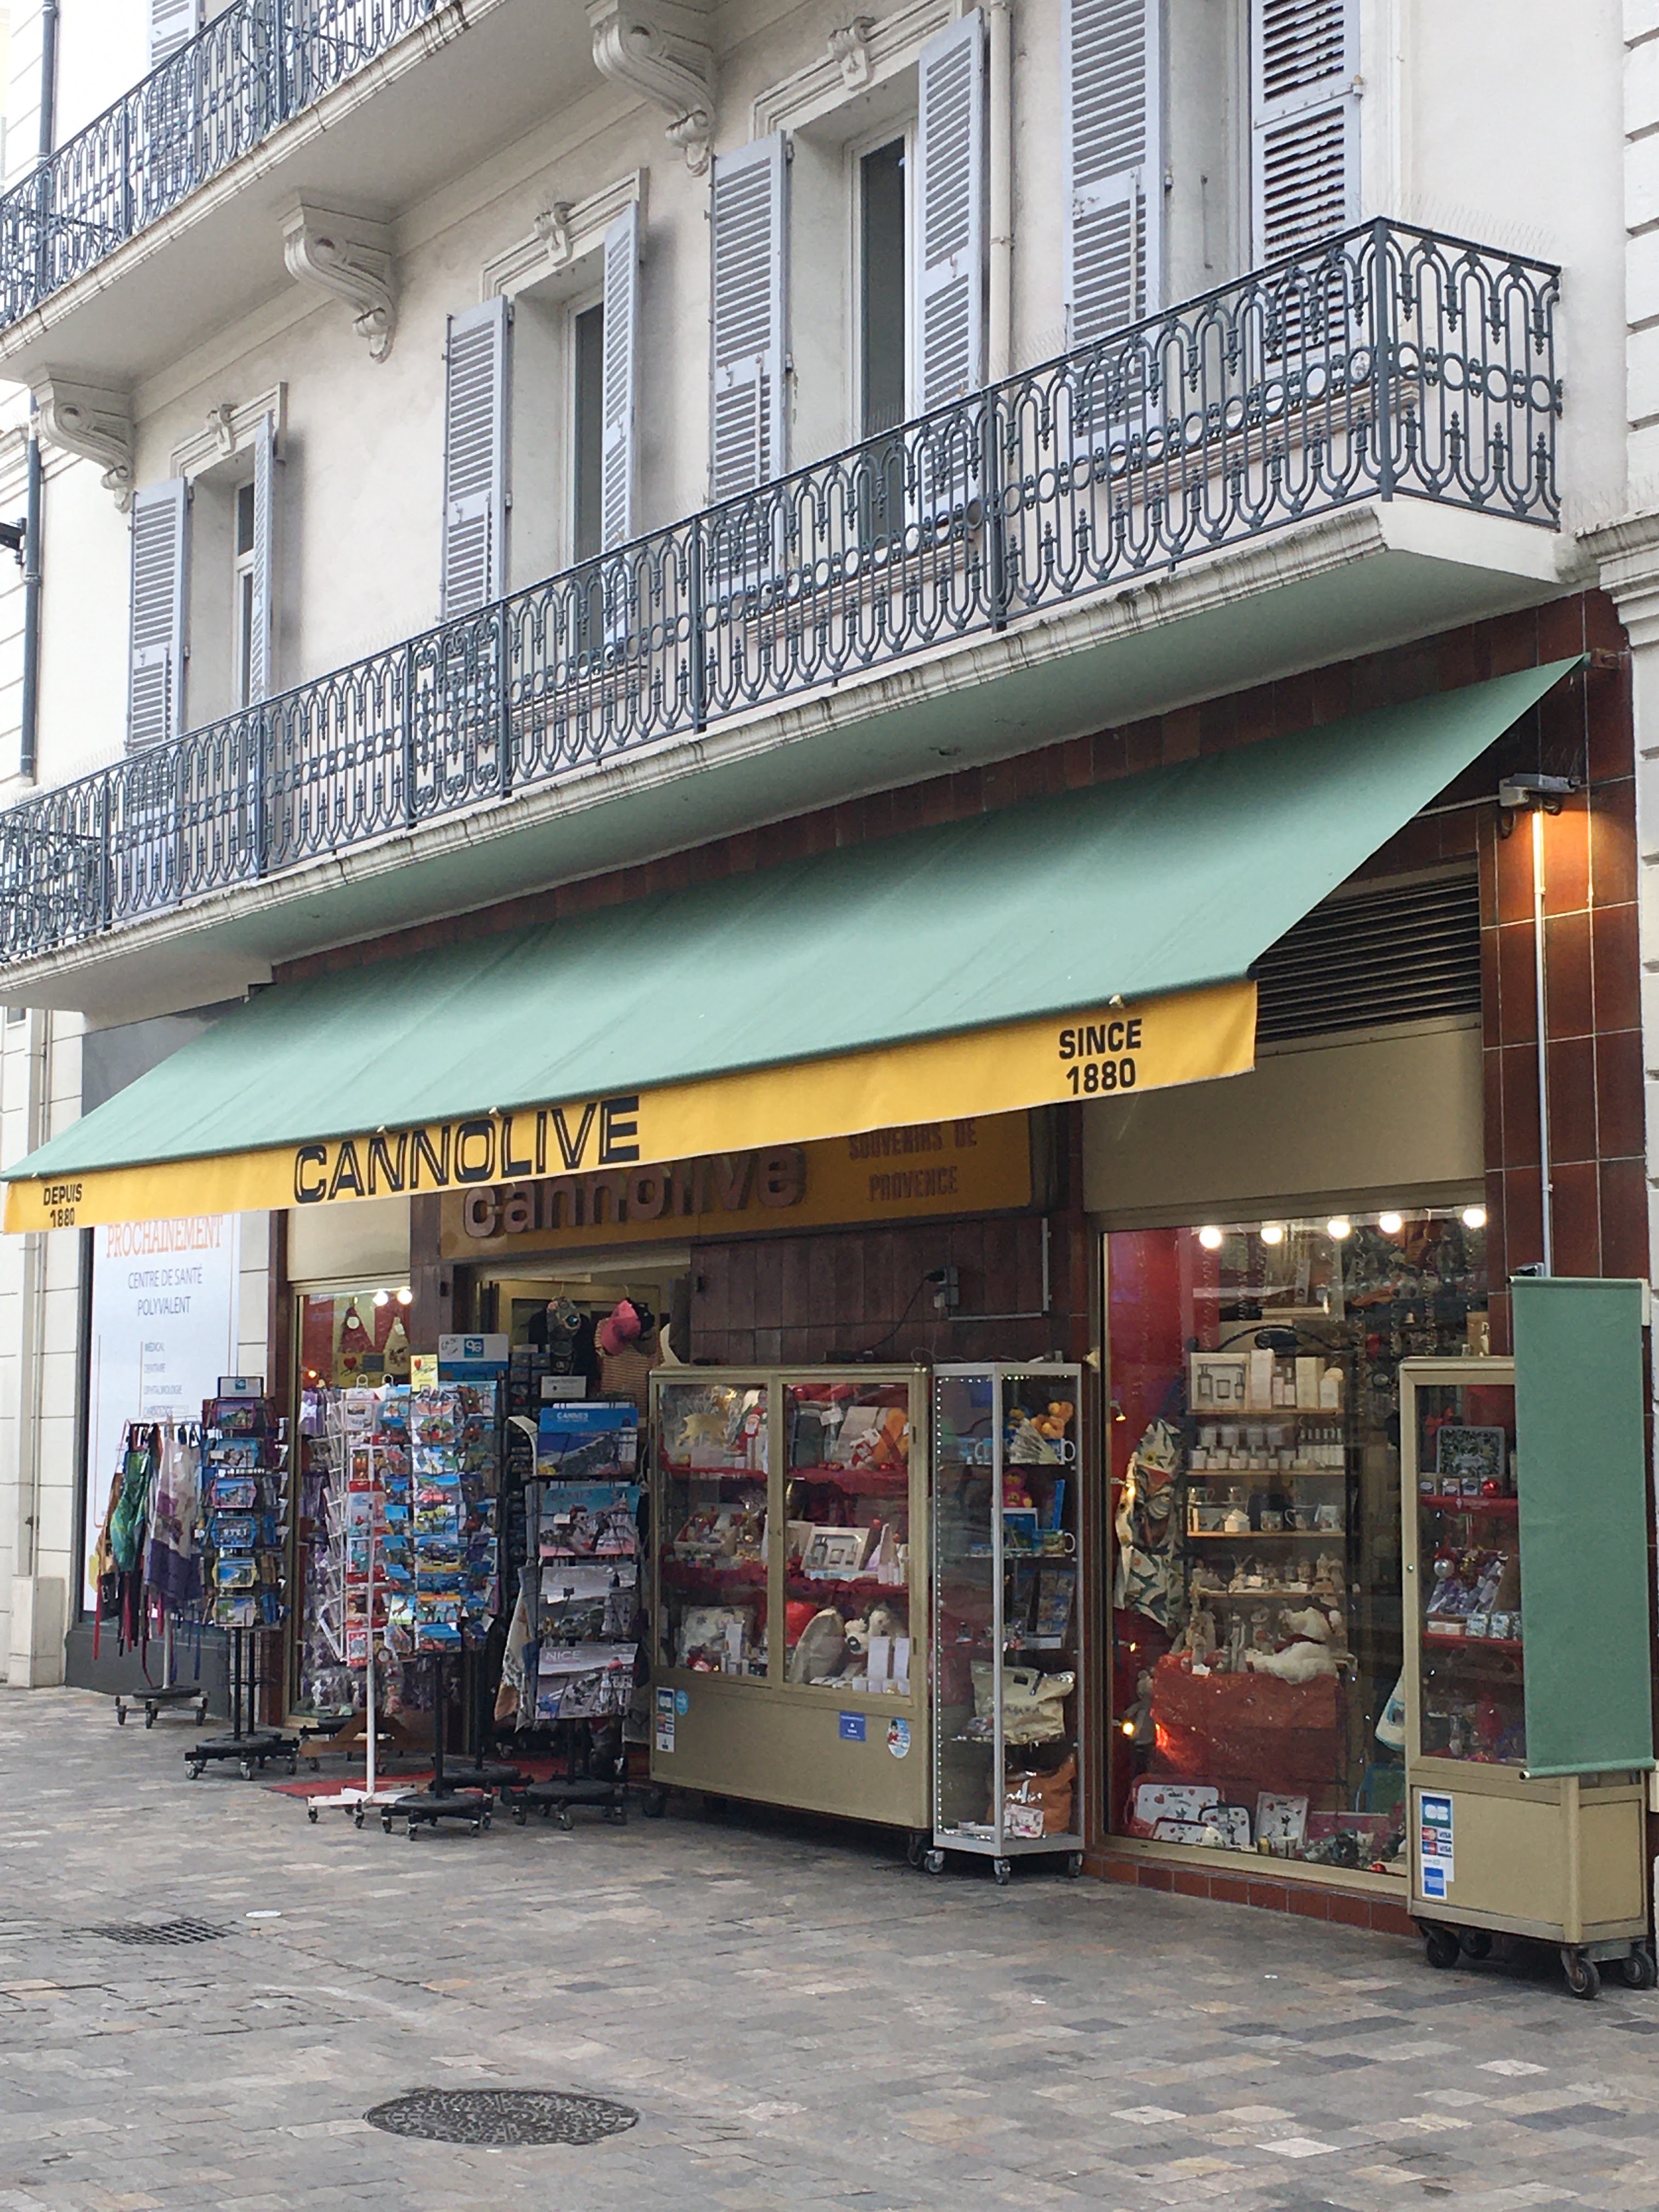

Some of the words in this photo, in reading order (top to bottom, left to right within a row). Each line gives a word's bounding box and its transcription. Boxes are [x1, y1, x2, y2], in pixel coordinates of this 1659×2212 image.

[1059, 1018, 1142, 1059] SINCE
[1066, 1058, 1136, 1095] 1880
[294, 1096, 640, 1204] CANNOLIVE
[848, 1124, 943, 1159] SOUVENIRS
[953, 1118, 977, 1147] DE
[43, 1183, 82, 1205] DEPUIS
[868, 1166, 959, 1201] PROVENCE
[50, 1207, 75, 1228] 1880
[106, 1215, 223, 1258] PROCHAINEMENT
[128, 1269, 160, 1289] CENTRE
[162, 1269, 173, 1287] DE
[175, 1263, 203, 1285] SANTÉ
[137, 1296, 191, 1316] POLYVALENT
[545, 1650, 582, 1660] NICE
